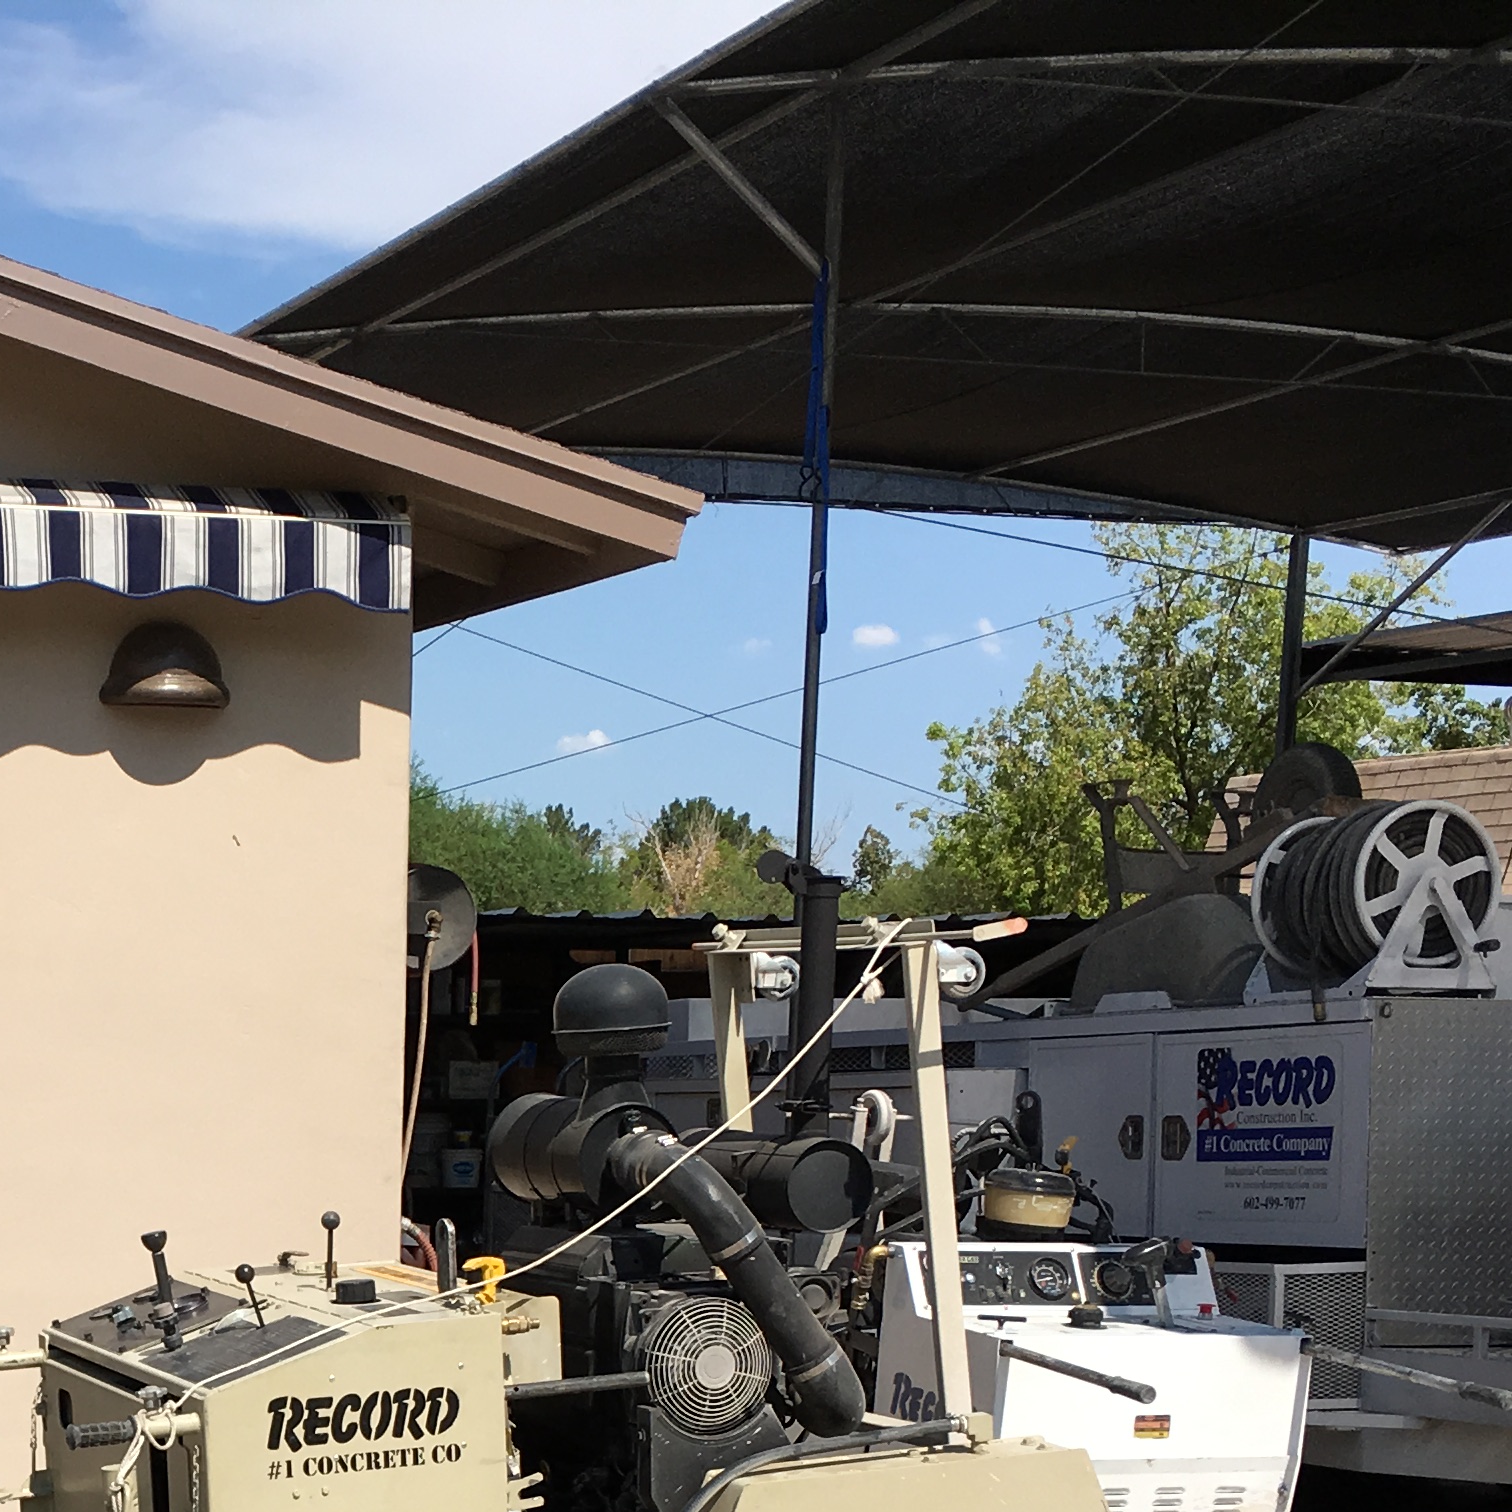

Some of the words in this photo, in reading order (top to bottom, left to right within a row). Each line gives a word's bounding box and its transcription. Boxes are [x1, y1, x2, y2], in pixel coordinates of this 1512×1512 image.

[1215, 1054, 1336, 1112] RECORD
[1236, 1111, 1297, 1125] Construction
[1300, 1110, 1318, 1123] Inc.
[1220, 1134, 1272, 1153] Concrete
[1272, 1133, 1331, 1156] Company
[1243, 1196, 1307, 1210] 602-499-7077
[267, 1386, 460, 1453] RECORD
[267, 1459, 294, 1480] #1
[302, 1446, 426, 1477] CONCRETE
